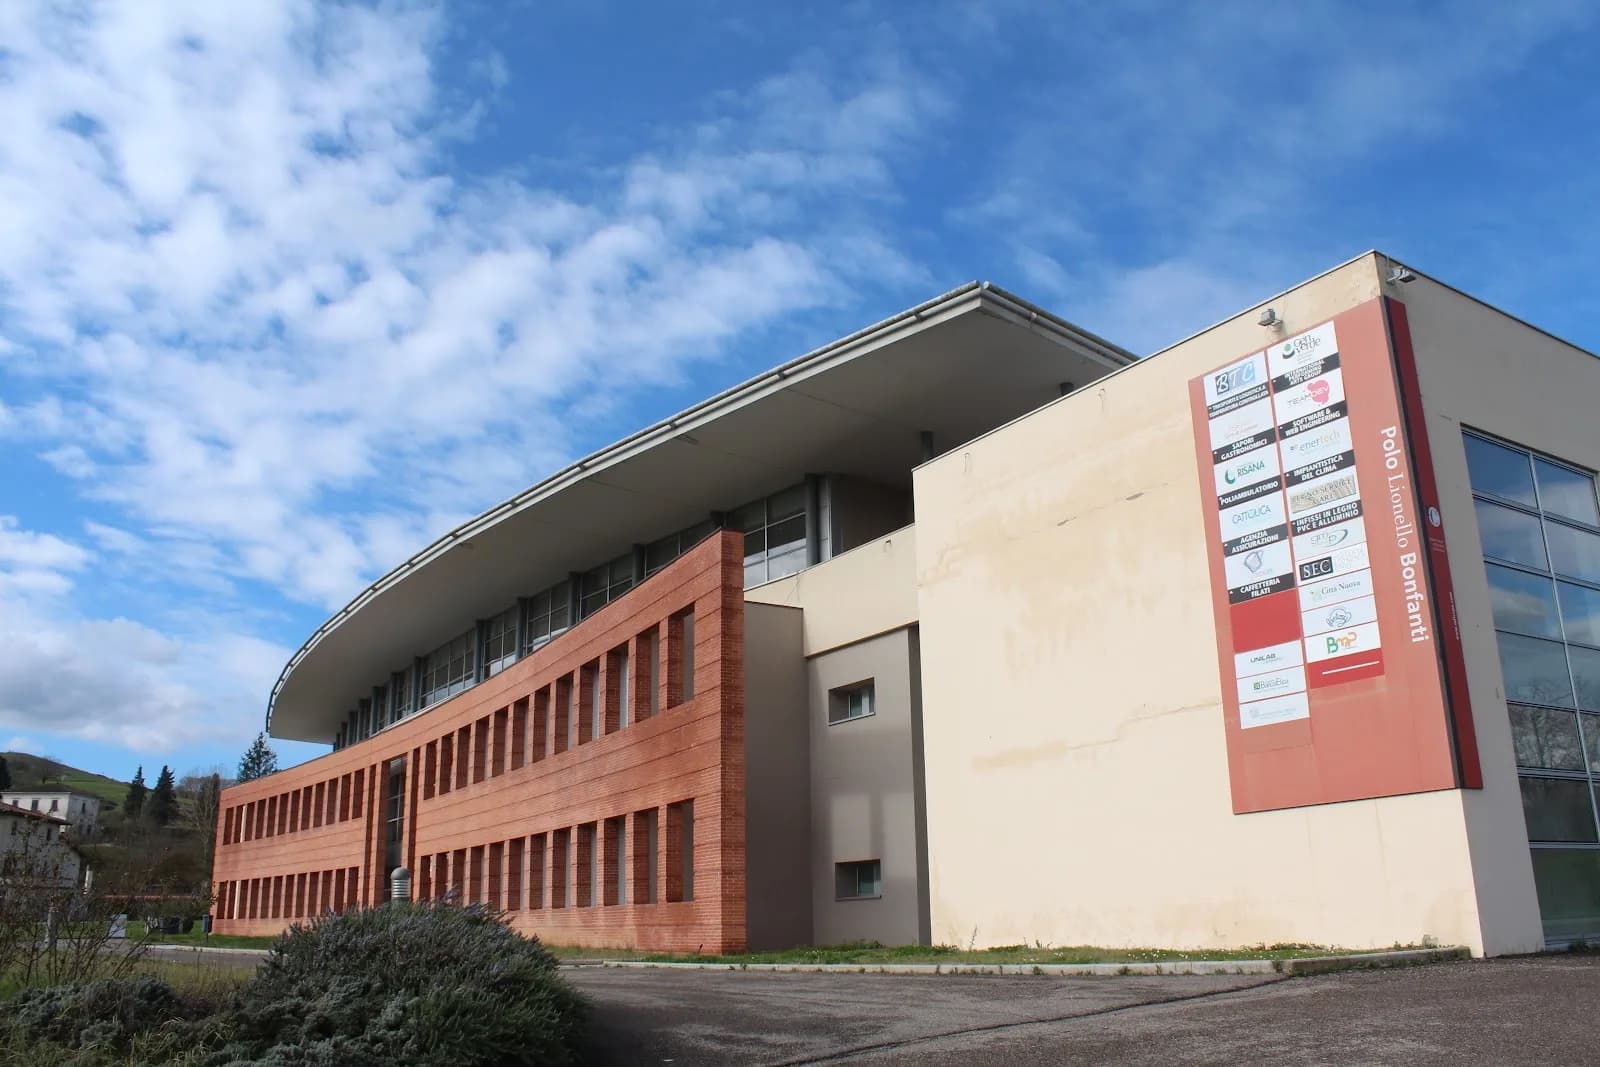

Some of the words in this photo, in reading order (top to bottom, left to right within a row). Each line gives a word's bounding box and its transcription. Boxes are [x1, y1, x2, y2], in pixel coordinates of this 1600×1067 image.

[1217, 362, 1254, 394] BTC
[1285, 426, 1299, 436] WEB
[1299, 411, 1341, 432] ENGINEERING
[1292, 409, 1325, 428] SOFTWARE
[1221, 438, 1268, 460] GASTRONOMICI
[1231, 436, 1255, 450] SAPORI
[1381, 426, 1401, 470] Polo
[1237, 460, 1265, 478] RISANA
[1294, 454, 1343, 477] IMPIANTISTICA
[1301, 470, 1314, 481] DEL
[1315, 464, 1338, 478] CLIMA
[1221, 480, 1279, 506] POLIAMBULATORIO
[1231, 504, 1271, 525] CATTOLICA
[1296, 512, 1322, 527] INFISSI
[1323, 510, 1332, 519] IN
[1332, 502, 1358, 516] LEGNO
[1297, 522, 1311, 533] PVC
[1318, 509, 1359, 527] ALLUMINIO
[1388, 472, 1413, 548] Lionello
[1231, 534, 1279, 554] ASSICURAZIONI
[1240, 529, 1268, 546] AGENZIA
[1303, 559, 1332, 579] SEC
[1400, 552, 1430, 643] Bonfanti
